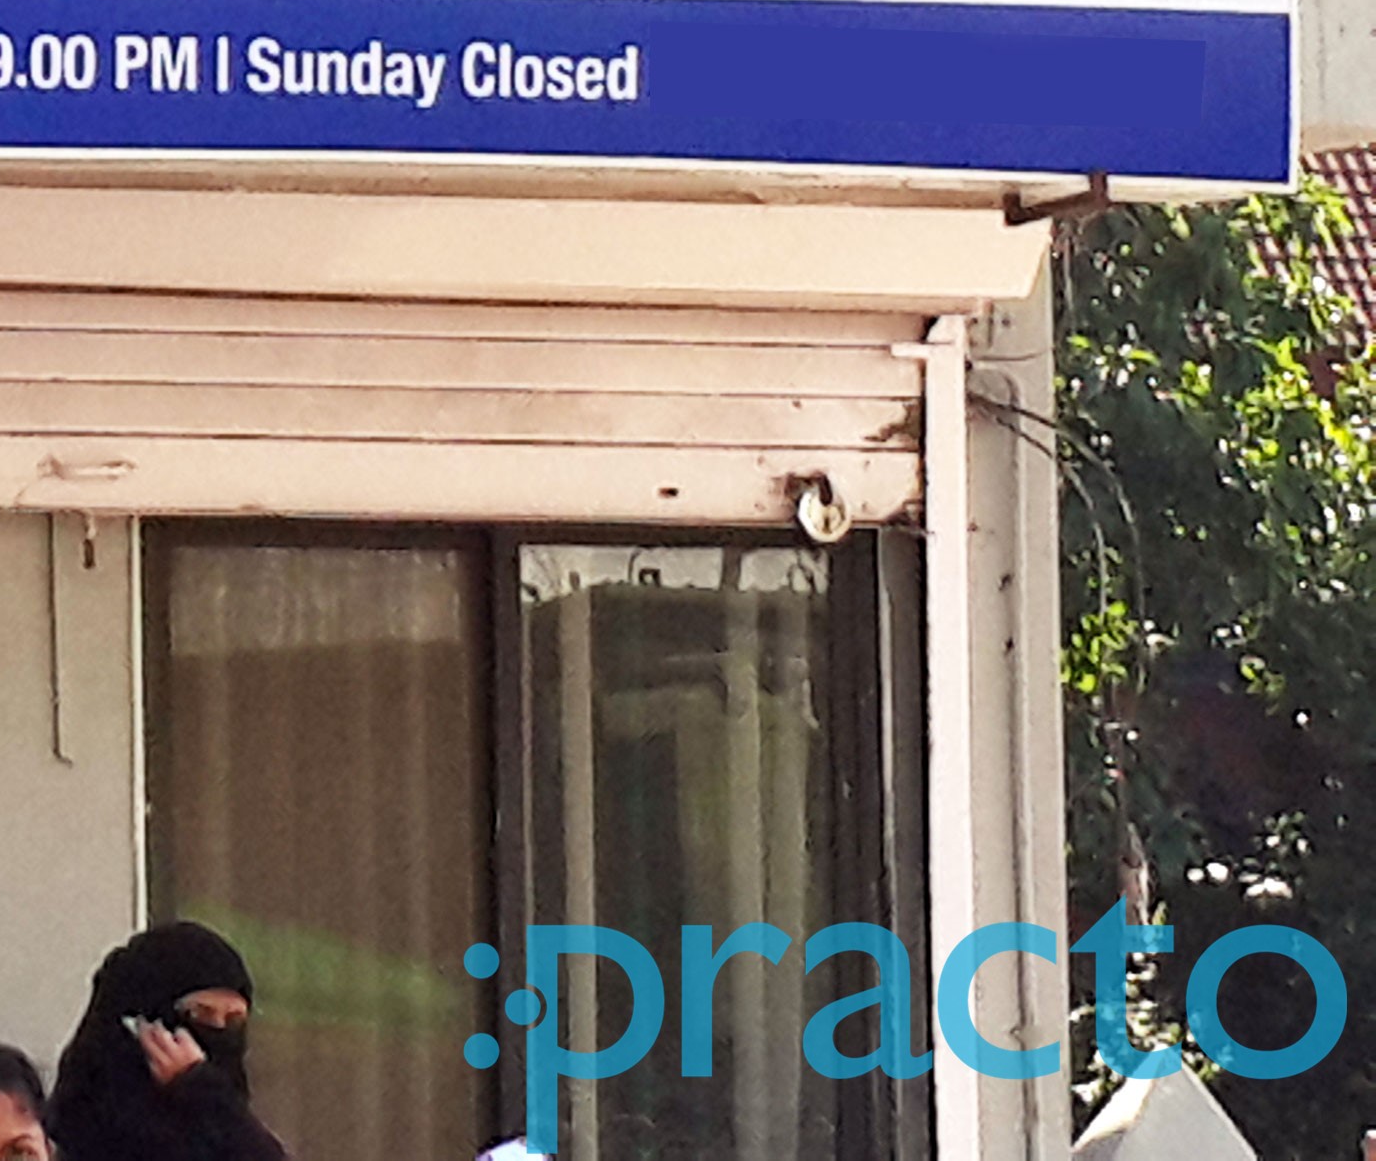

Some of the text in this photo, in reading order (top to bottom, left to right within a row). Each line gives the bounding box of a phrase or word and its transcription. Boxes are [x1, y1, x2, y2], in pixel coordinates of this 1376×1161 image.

[115, 36, 198, 92] PM
[246, 38, 445, 107] Sunday
[461, 44, 639, 103] Closed
